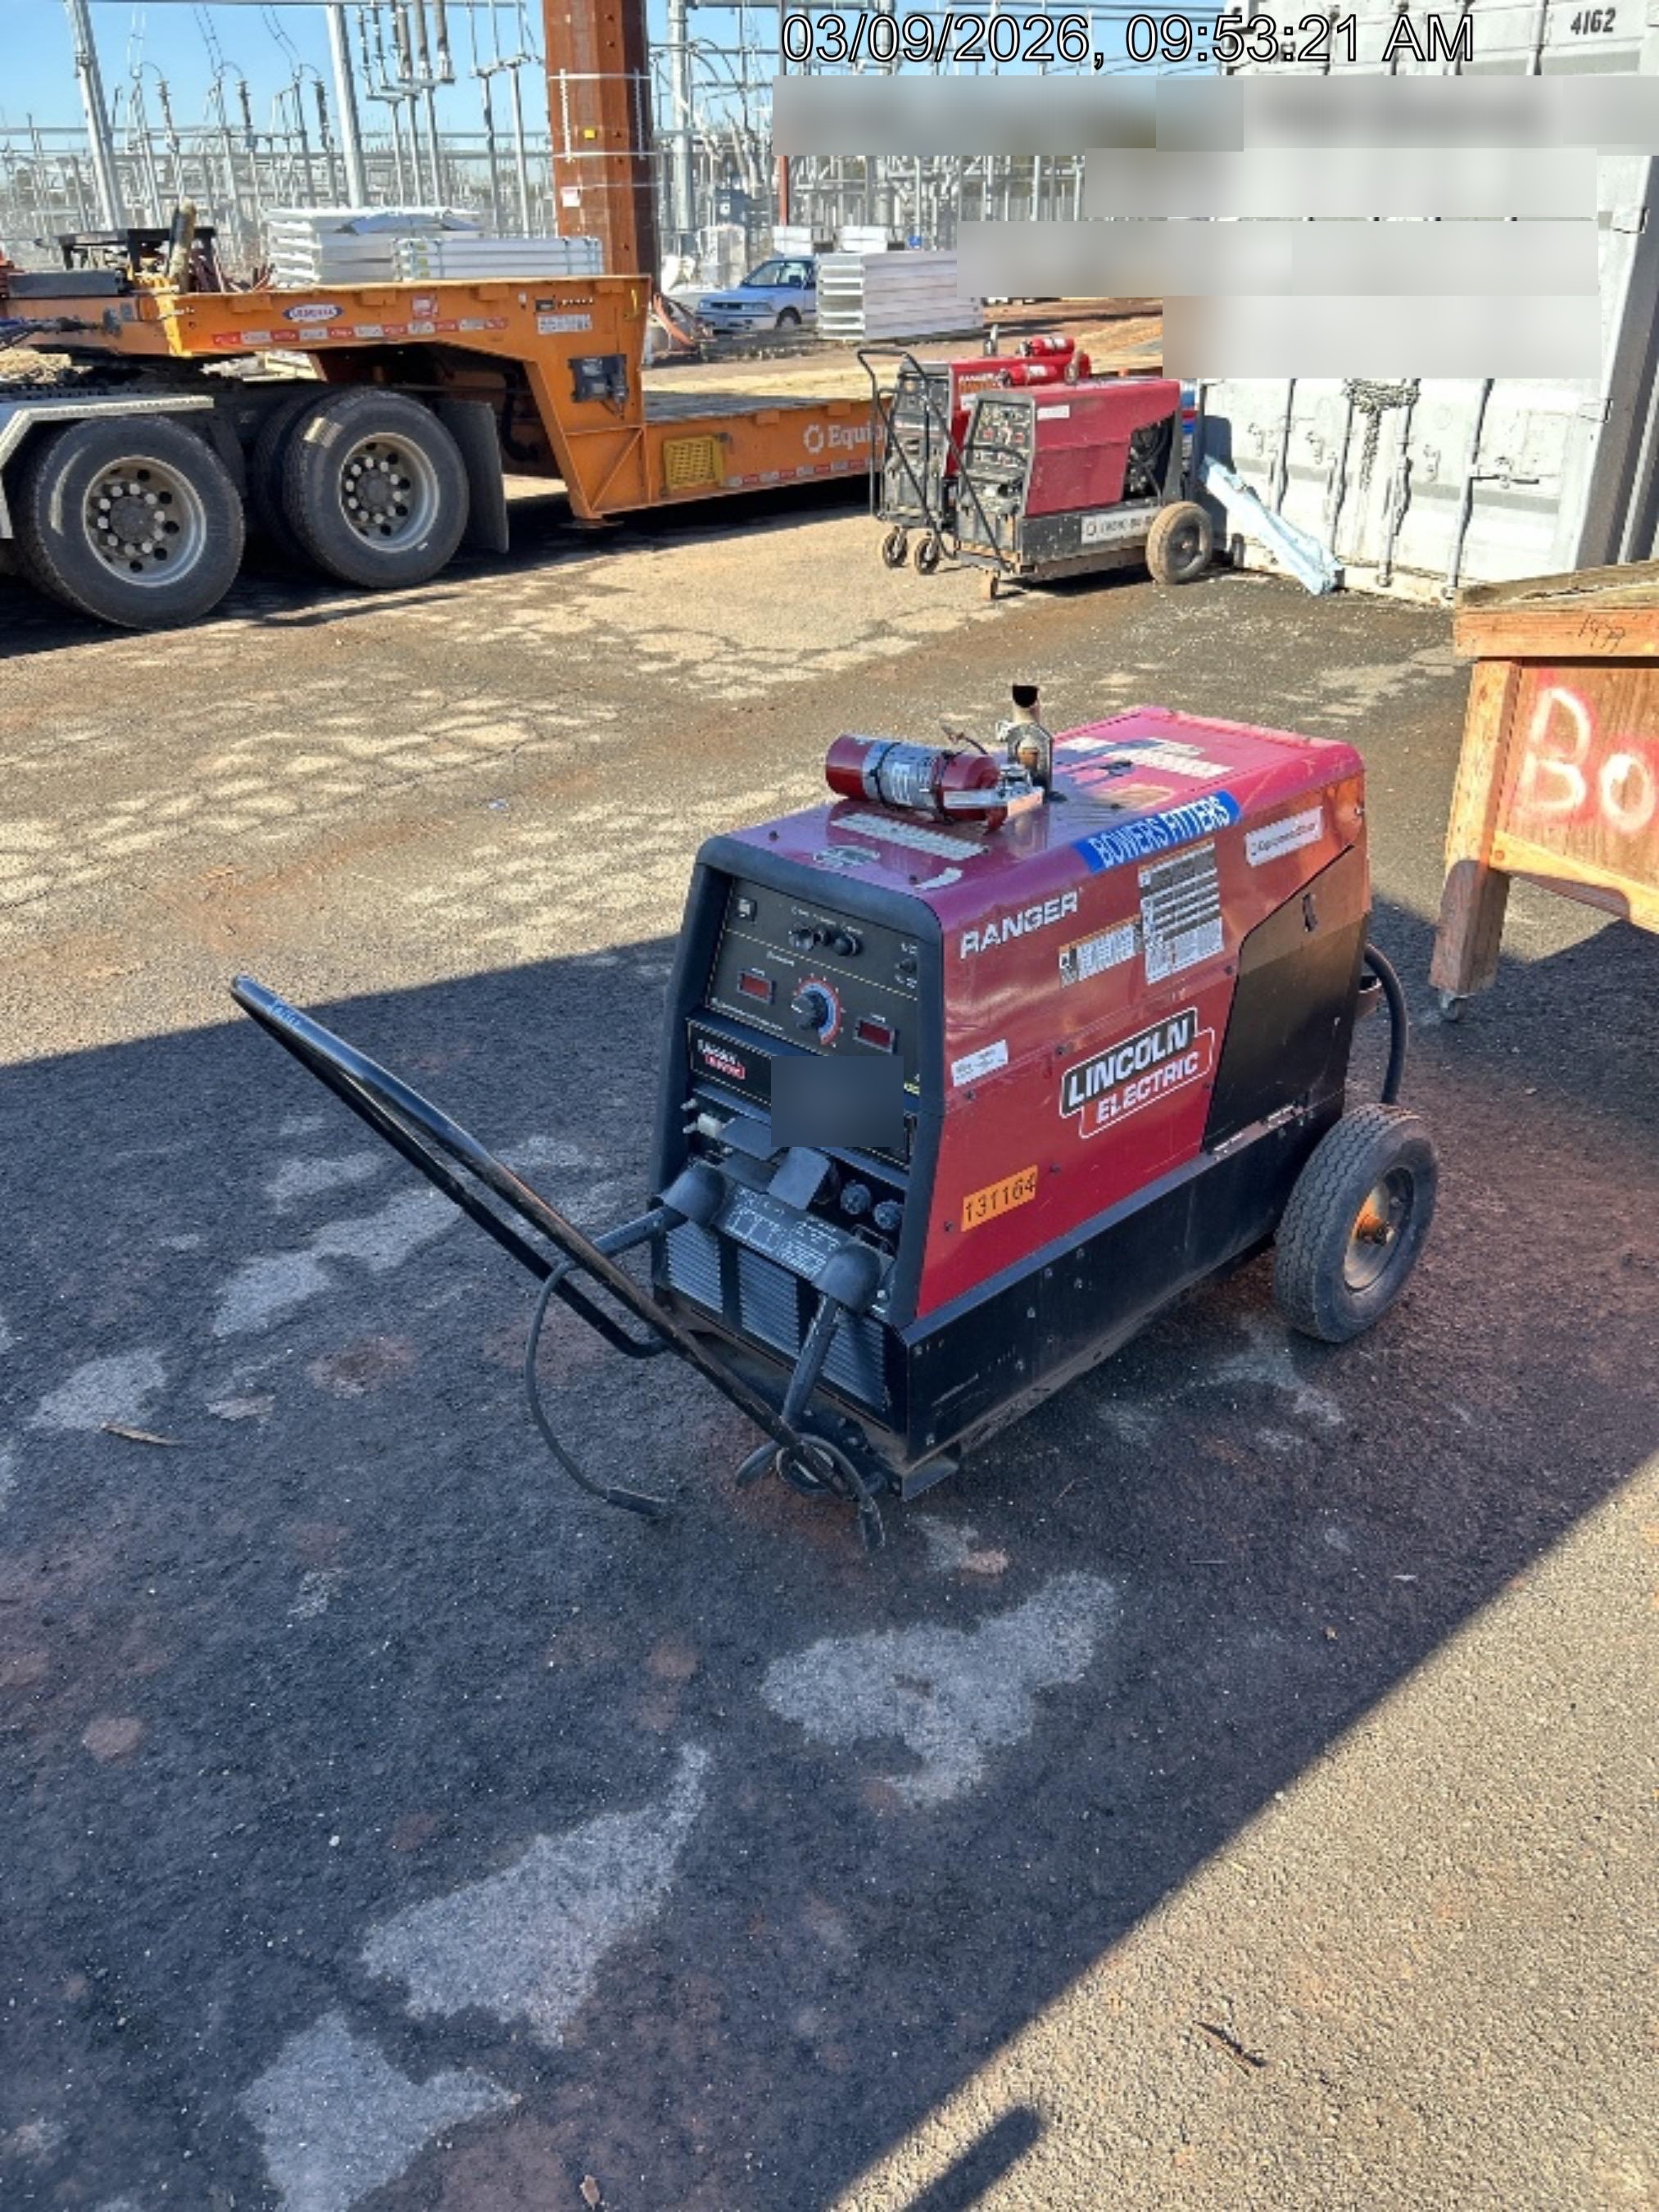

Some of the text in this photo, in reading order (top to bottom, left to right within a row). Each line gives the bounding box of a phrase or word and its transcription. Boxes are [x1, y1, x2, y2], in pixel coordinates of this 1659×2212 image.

[1571, 7, 1616, 35] 4162
[1088, 817, 1169, 869] BOWERS
[1158, 795, 1231, 844] FITTERS
[960, 891, 1078, 960] RANGER
[1068, 1018, 1188, 1107] LINCOLN
[1096, 1051, 1199, 1124] ELECTRIC
[965, 1172, 1036, 1222] 131164
